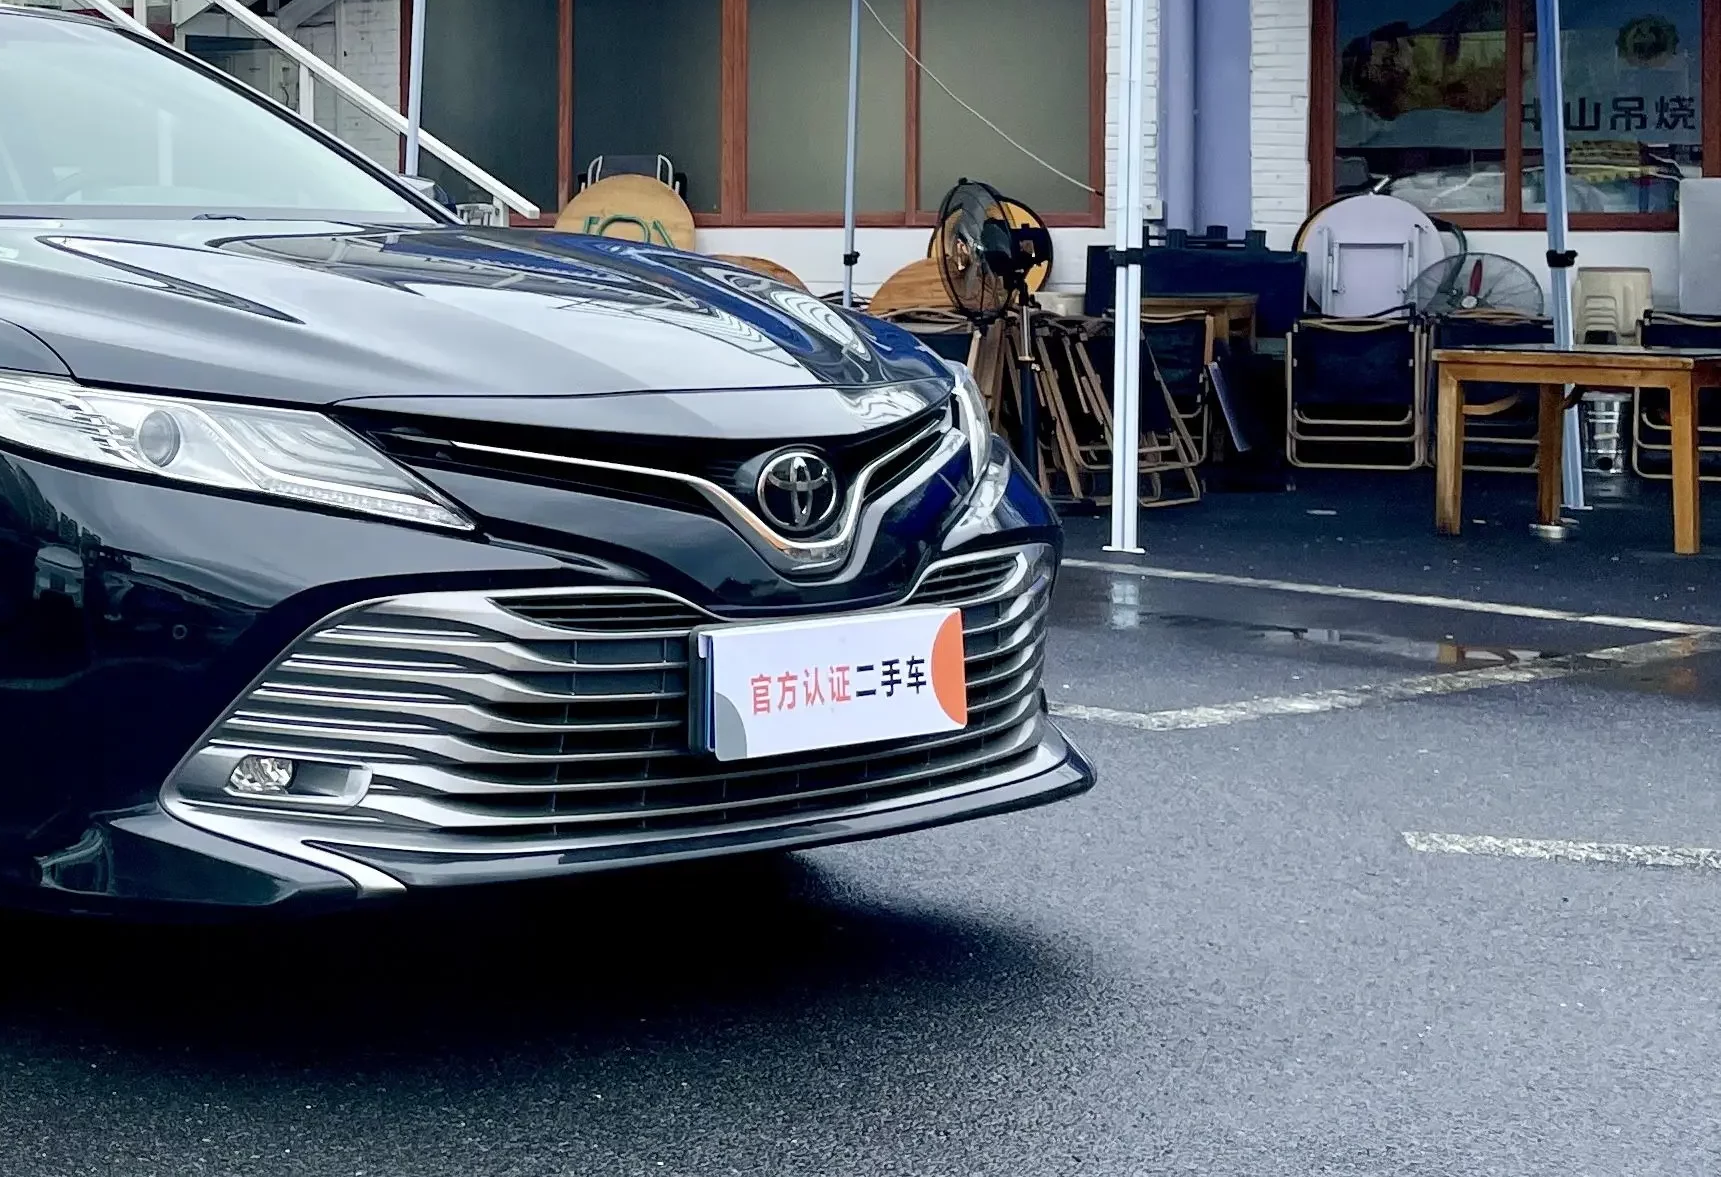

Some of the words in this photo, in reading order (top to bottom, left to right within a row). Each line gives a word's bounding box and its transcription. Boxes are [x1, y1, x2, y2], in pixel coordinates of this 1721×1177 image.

[749, 655, 928, 716] 官方认证二手车
